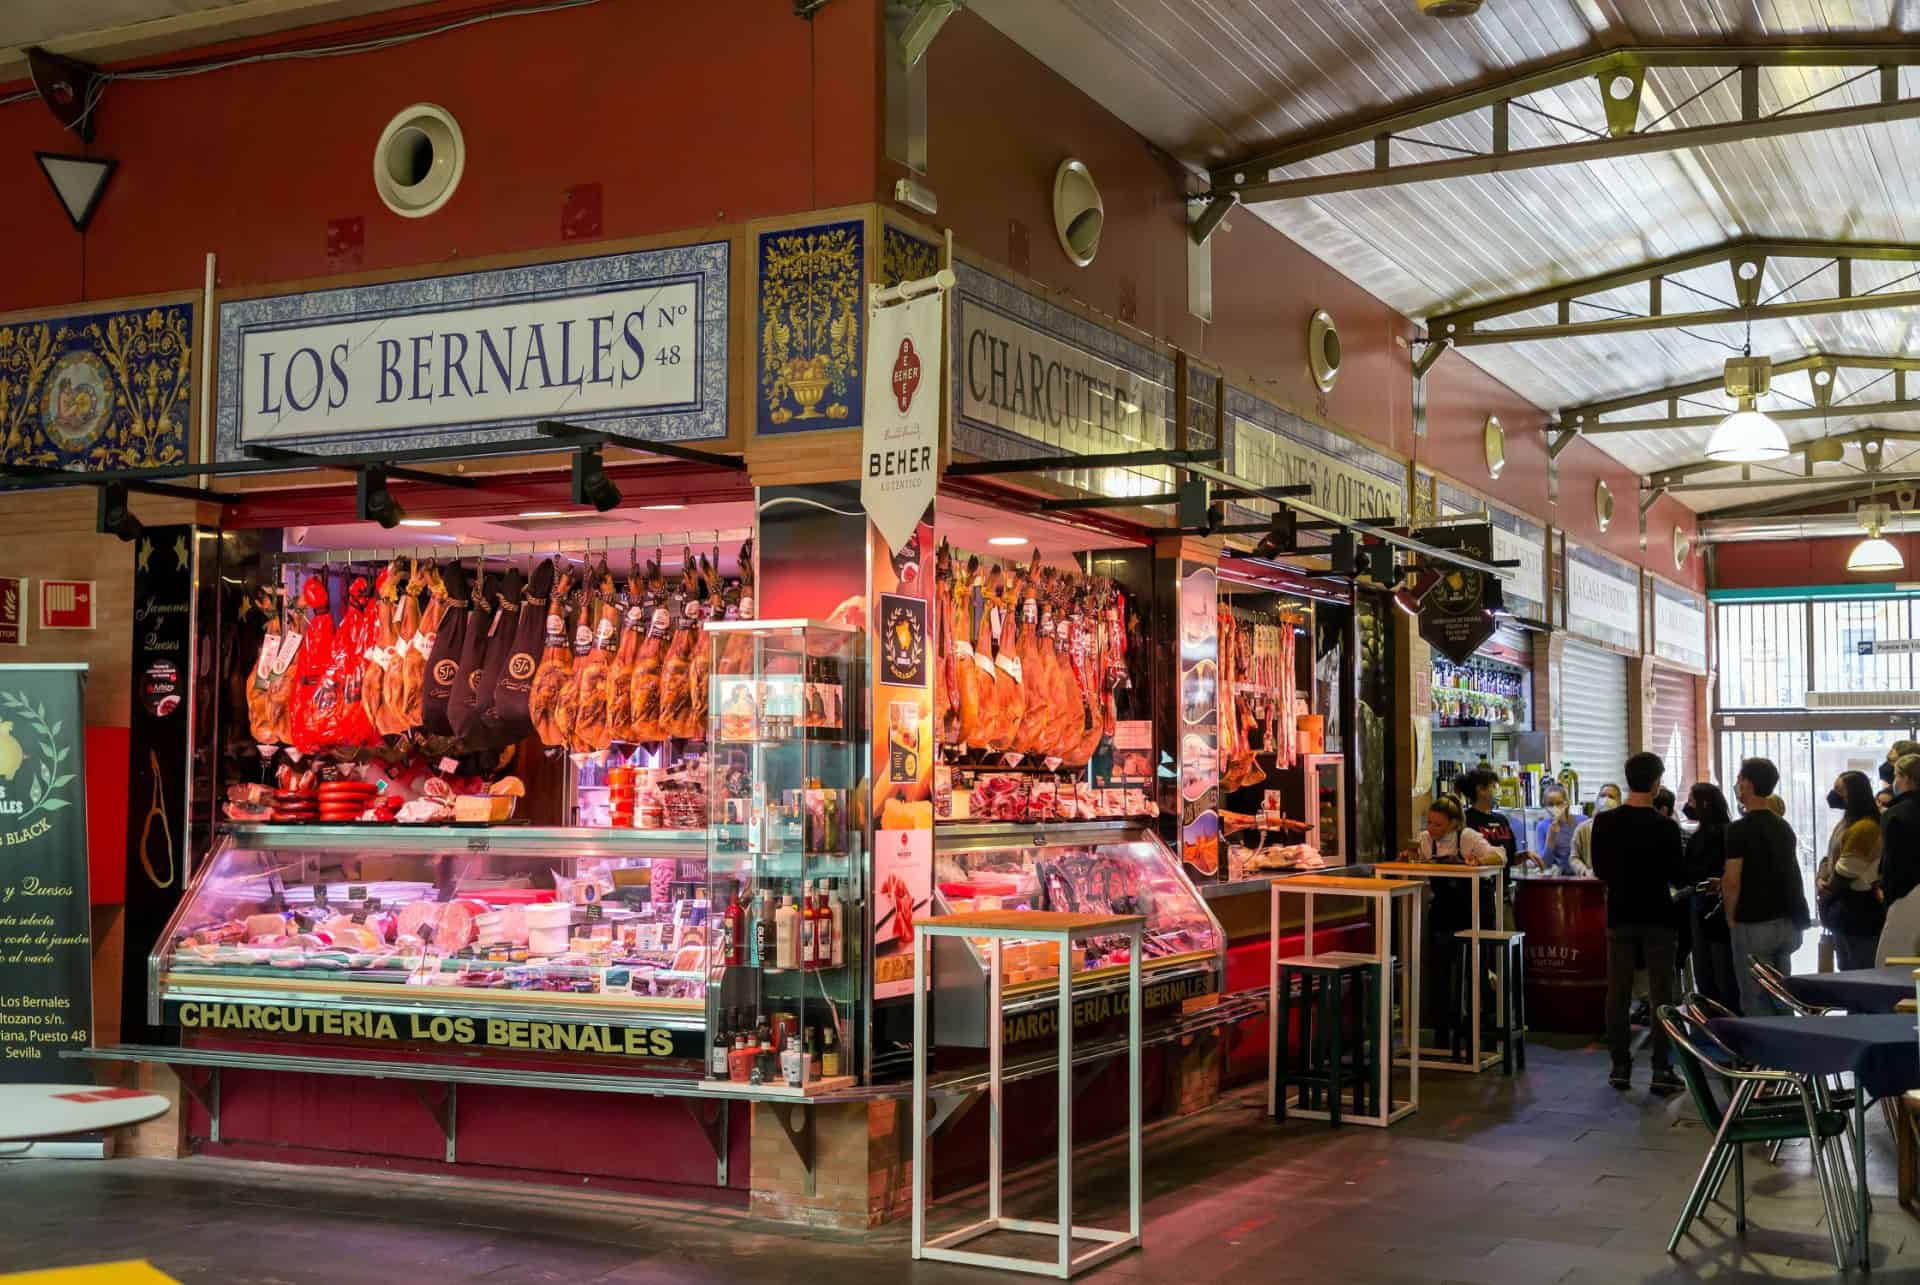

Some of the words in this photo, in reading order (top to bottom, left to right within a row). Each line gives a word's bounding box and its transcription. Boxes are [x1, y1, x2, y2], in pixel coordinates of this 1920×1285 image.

[257, 338, 350, 423] LOS
[376, 306, 646, 406] BERNALES
[655, 344, 681, 366] 48
[869, 446, 931, 477] BEHER
[1337, 472, 1392, 519] QUESOS
[6, 817, 50, 846] BLACK
[2, 887, 15, 903] y
[21, 876, 73, 896] Quesos
[19, 912, 54, 926] selecta
[5, 933, 32, 945] corte
[35, 931, 49, 945] de
[46, 933, 89, 951] jamón
[9, 950, 24, 963] al
[0, 995, 20, 1008] Los
[22, 995, 71, 1009] Bernales
[1113, 991, 1130, 1016] LO
[44, 1013, 65, 1025] s/n.
[29, 1030, 69, 1042] Puesto
[71, 1029, 87, 1042] 48
[410, 1013, 476, 1044] LOS
[487, 1018, 673, 1056] BERNALES
[5, 1046, 41, 1059] Sevilla
